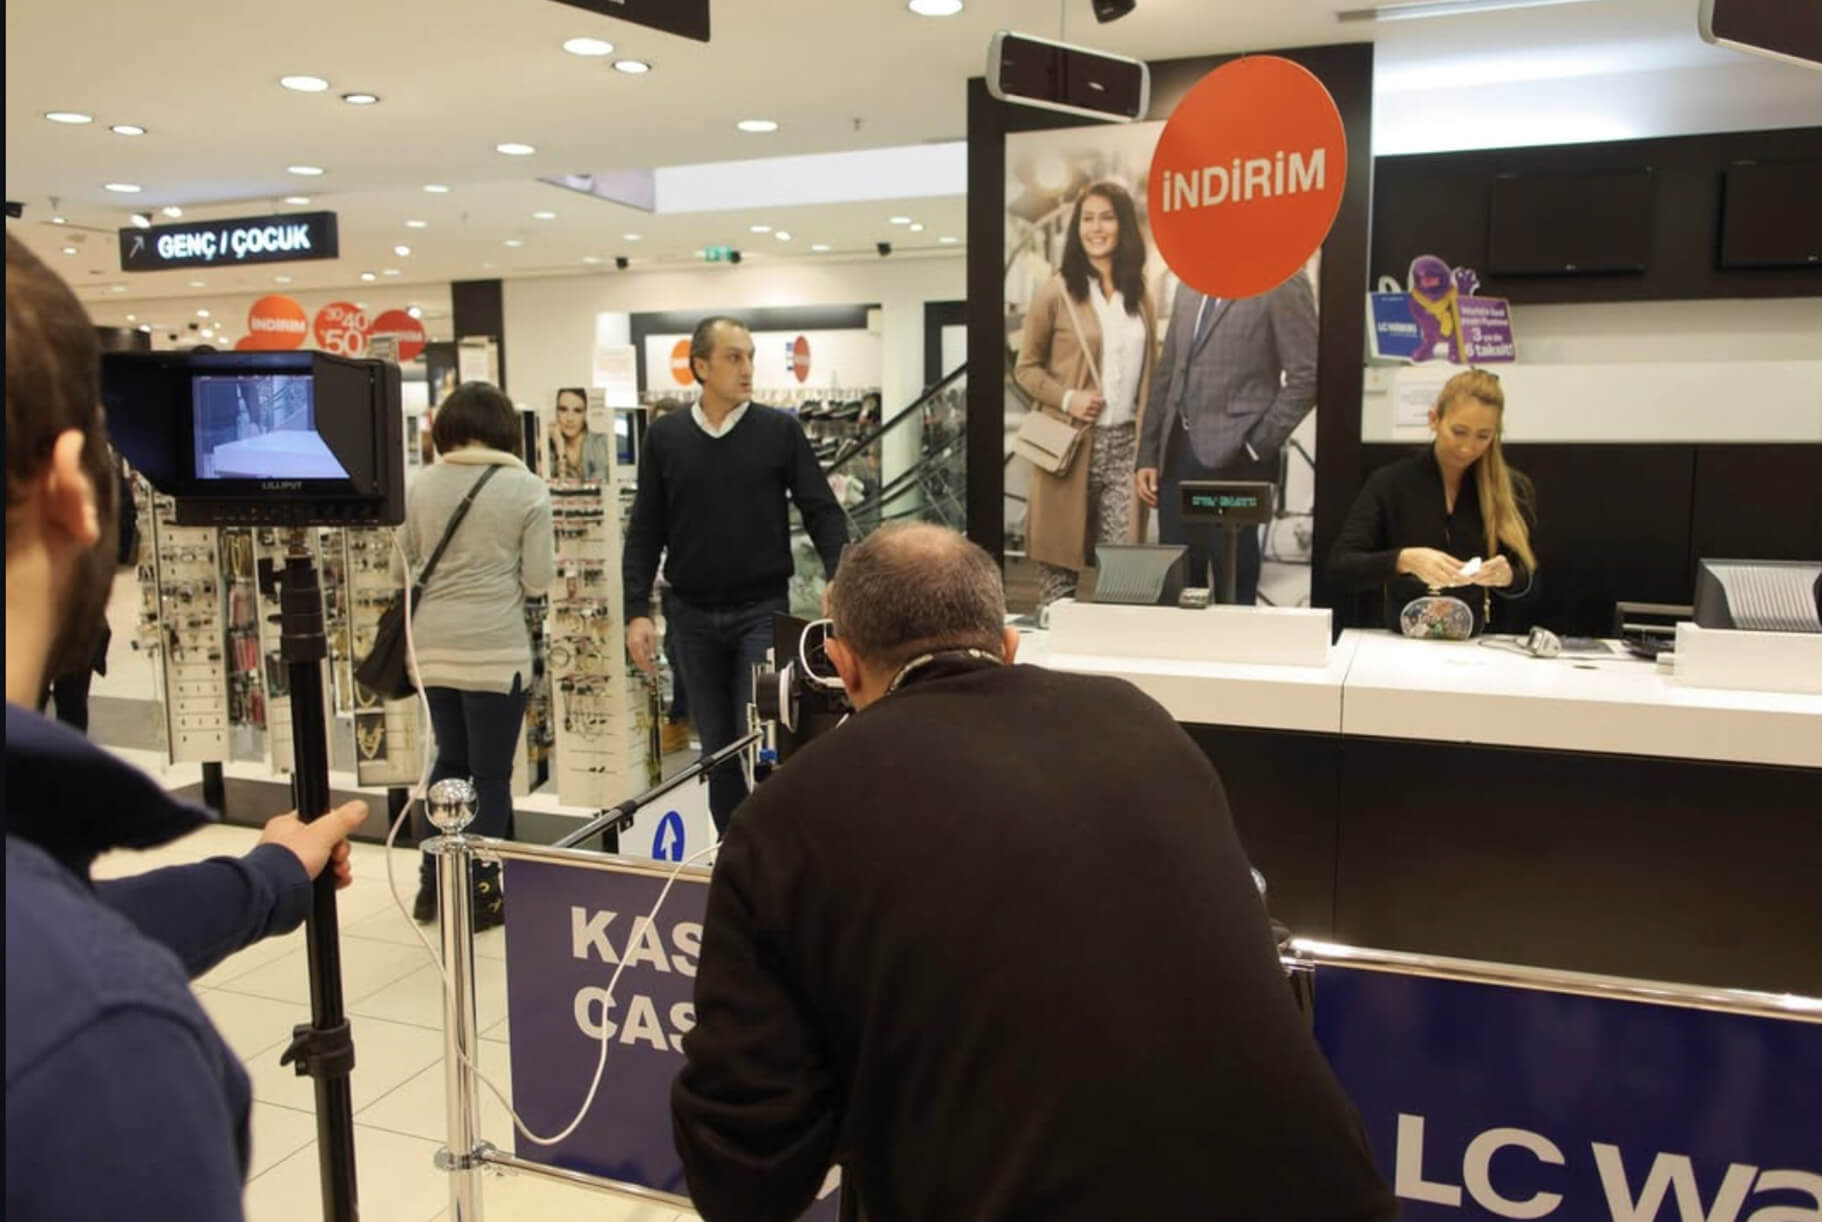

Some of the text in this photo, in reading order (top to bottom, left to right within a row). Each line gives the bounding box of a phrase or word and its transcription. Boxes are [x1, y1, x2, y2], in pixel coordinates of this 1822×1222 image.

[157, 231, 217, 260] GENÇ
[231, 223, 311, 258] ÇOCUK
[571, 906, 703, 977] KAS
[1395, 1113, 1566, 1219] LC
